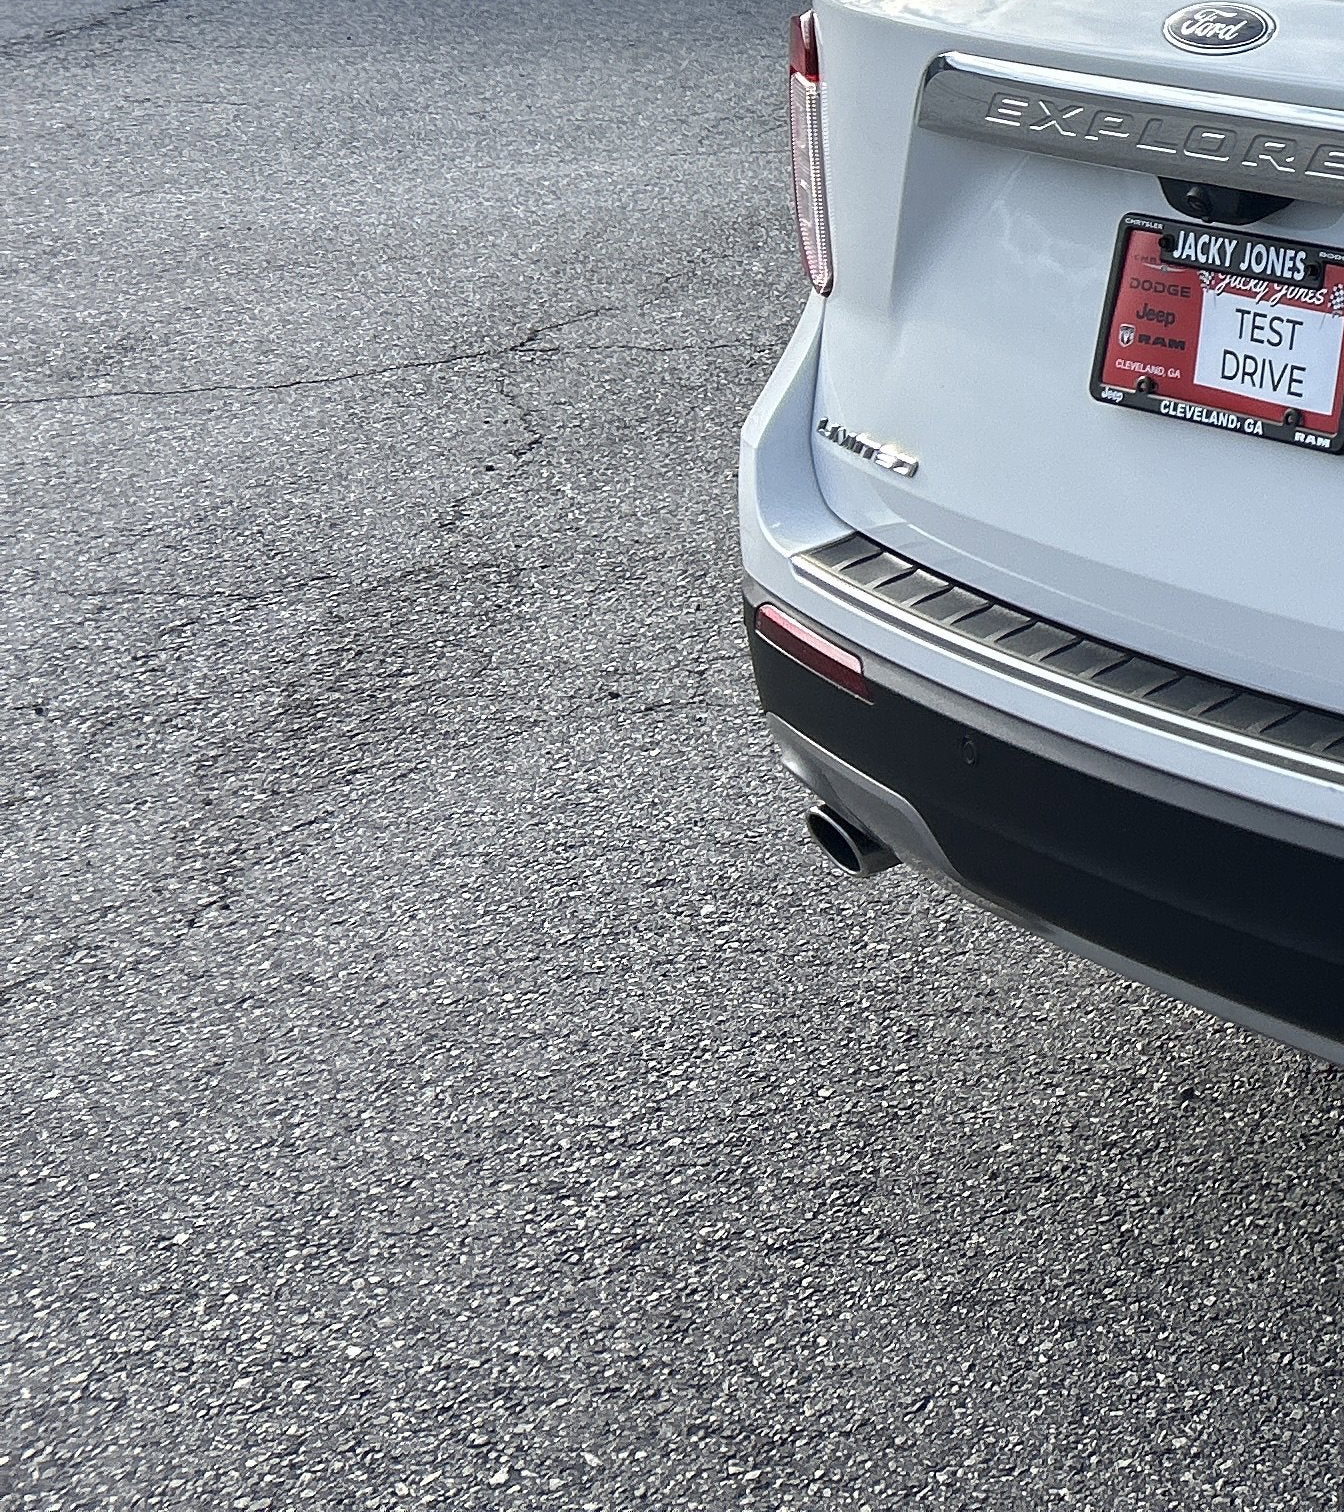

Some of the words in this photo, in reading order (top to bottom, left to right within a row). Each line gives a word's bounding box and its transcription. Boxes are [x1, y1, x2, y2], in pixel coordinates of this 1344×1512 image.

[1181, 8, 1247, 41] Ford
[1125, 217, 1164, 230] CHRYSLER
[1172, 230, 1238, 268] JACKY
[1238, 242, 1307, 282] JONES
[1129, 276, 1192, 299] DODGE
[1135, 302, 1176, 328] Jeep
[1235, 308, 1304, 351] TEST
[1137, 333, 1186, 351] RAM
[1115, 358, 1166, 378] CLEVELAND,
[1167, 367, 1181, 379] GA
[1220, 348, 1307, 398] DRIVE
[1101, 386, 1124, 403] Jeep
[1159, 399, 1241, 430] CLEVELAND,
[1243, 419, 1264, 436] GA
[1294, 431, 1331, 449] RAM
